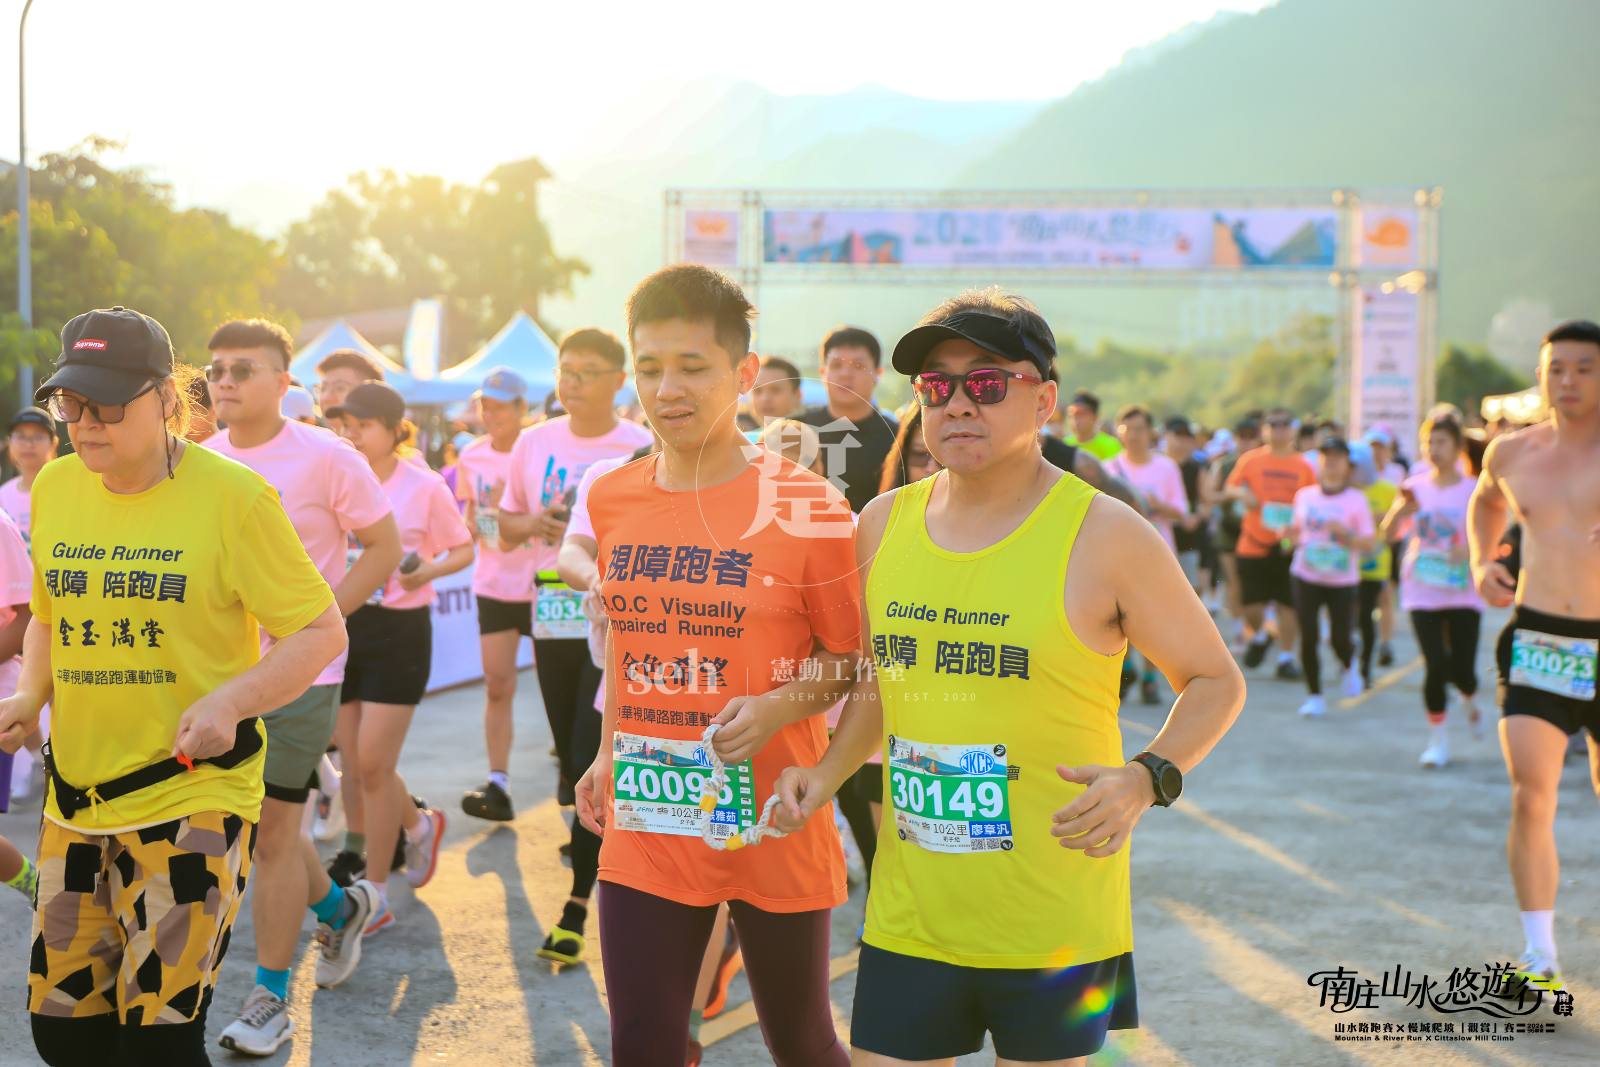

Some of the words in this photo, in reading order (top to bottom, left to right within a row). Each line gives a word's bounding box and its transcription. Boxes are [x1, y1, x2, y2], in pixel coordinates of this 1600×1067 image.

[52, 542, 106, 561] Guide
[110, 545, 183, 562] Runner
[606, 544, 754, 588] 視障跑者
[660, 597, 747, 623] Visually
[886, 601, 938, 622] Guide
[943, 608, 1010, 627] Runner
[612, 618, 667, 635] mpaired
[678, 620, 745, 639] Runner
[1517, 648, 1593, 679] 30023
[892, 771, 1004, 819] 30149
[933, 823, 968, 836] 10公里
